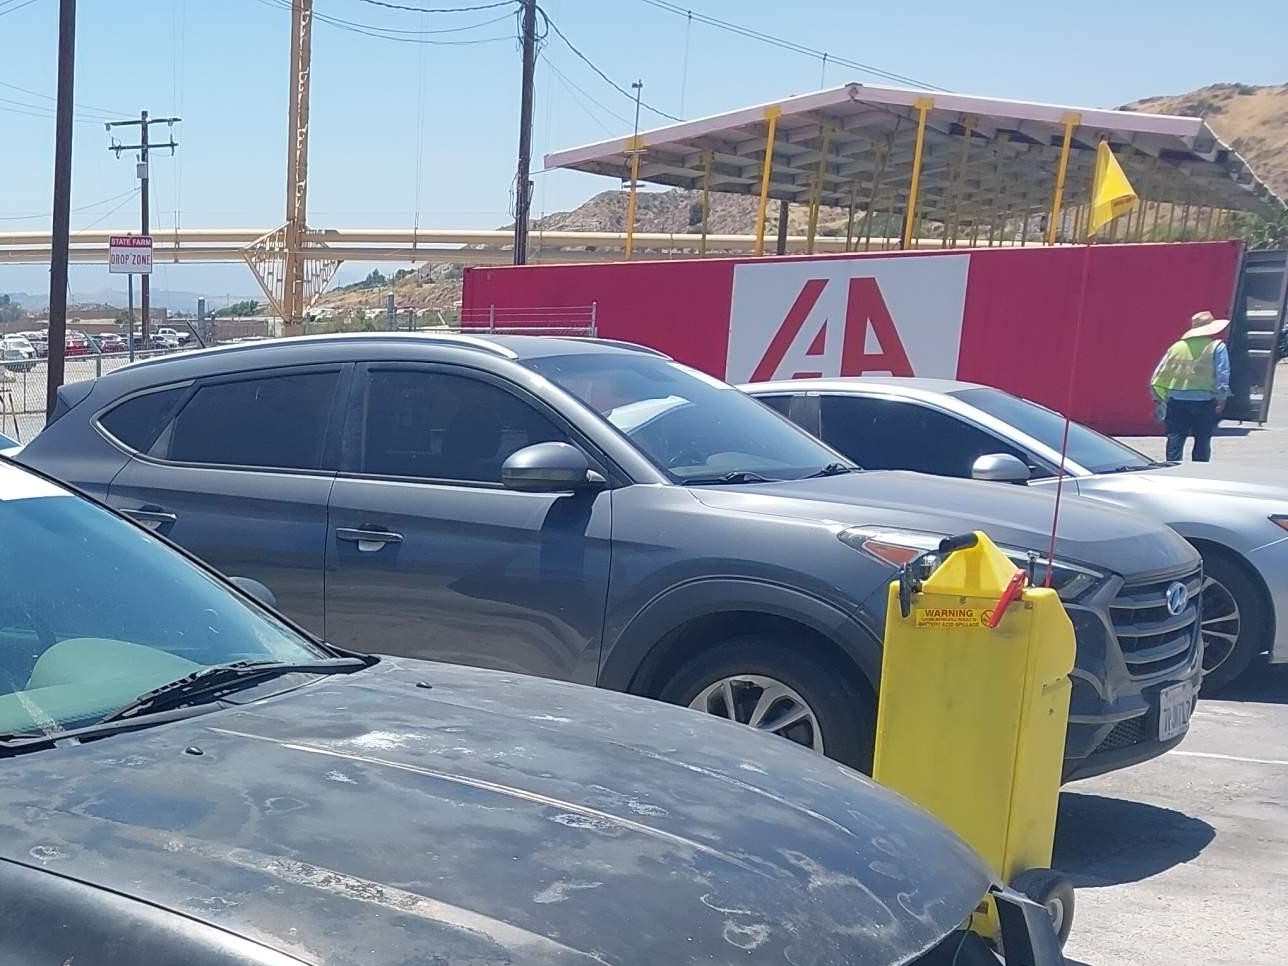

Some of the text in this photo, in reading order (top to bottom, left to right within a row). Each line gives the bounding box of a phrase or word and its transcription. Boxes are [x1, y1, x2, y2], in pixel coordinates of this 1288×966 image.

[111, 238, 151, 246] STATE FARM
[111, 254, 151, 265] DROP ZONE
[925, 609, 973, 617] WARNING
